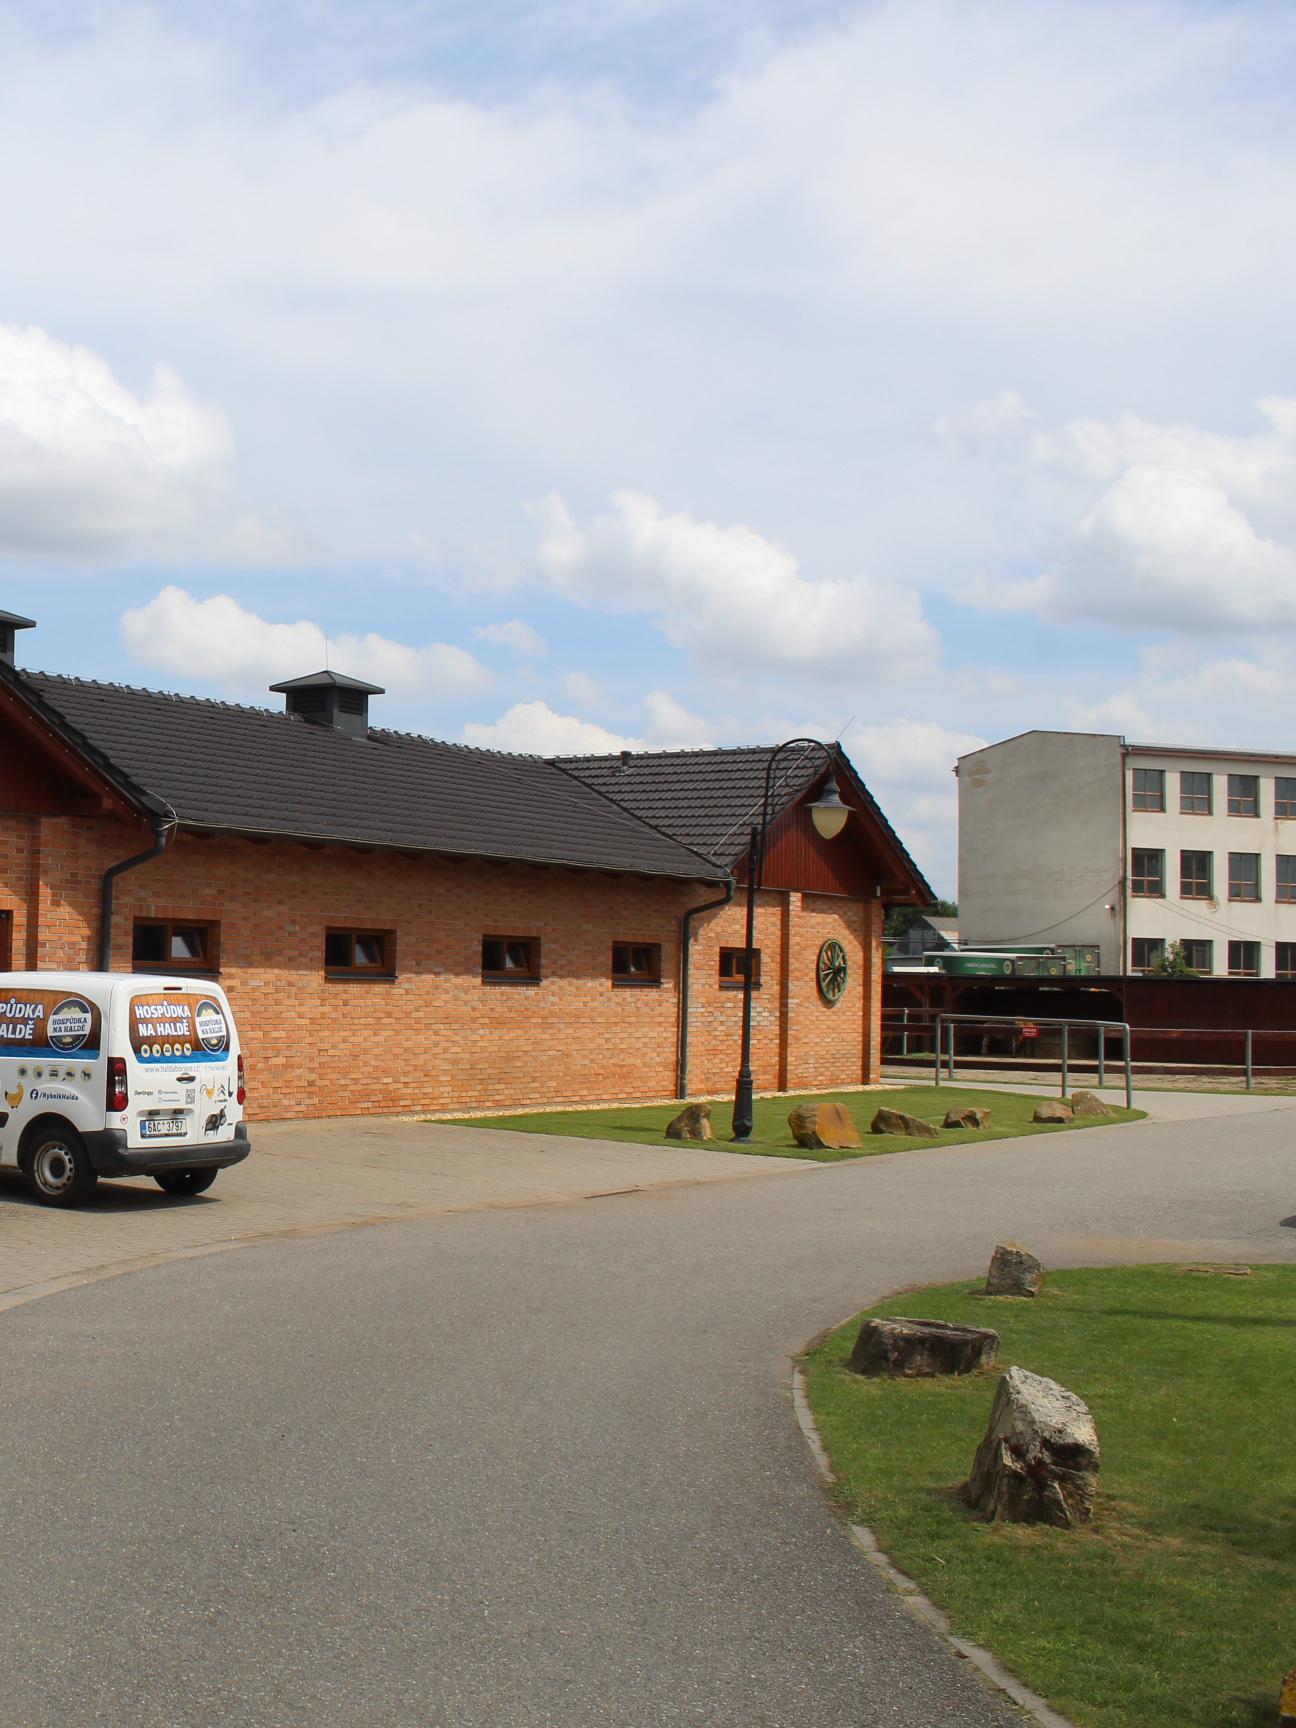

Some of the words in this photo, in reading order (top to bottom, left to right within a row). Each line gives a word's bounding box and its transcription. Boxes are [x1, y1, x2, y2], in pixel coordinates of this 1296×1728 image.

[134, 1001, 192, 1019] HOSPŮDKA
[52, 1015, 88, 1026] HOSPŮDKA
[64, 1024, 86, 1033] HALDĚ
[138, 1023, 156, 1037] NA
[156, 1019, 190, 1036] HALDĚ
[147, 1122, 162, 1133] 6AC
[166, 1120, 183, 1132] 3797
